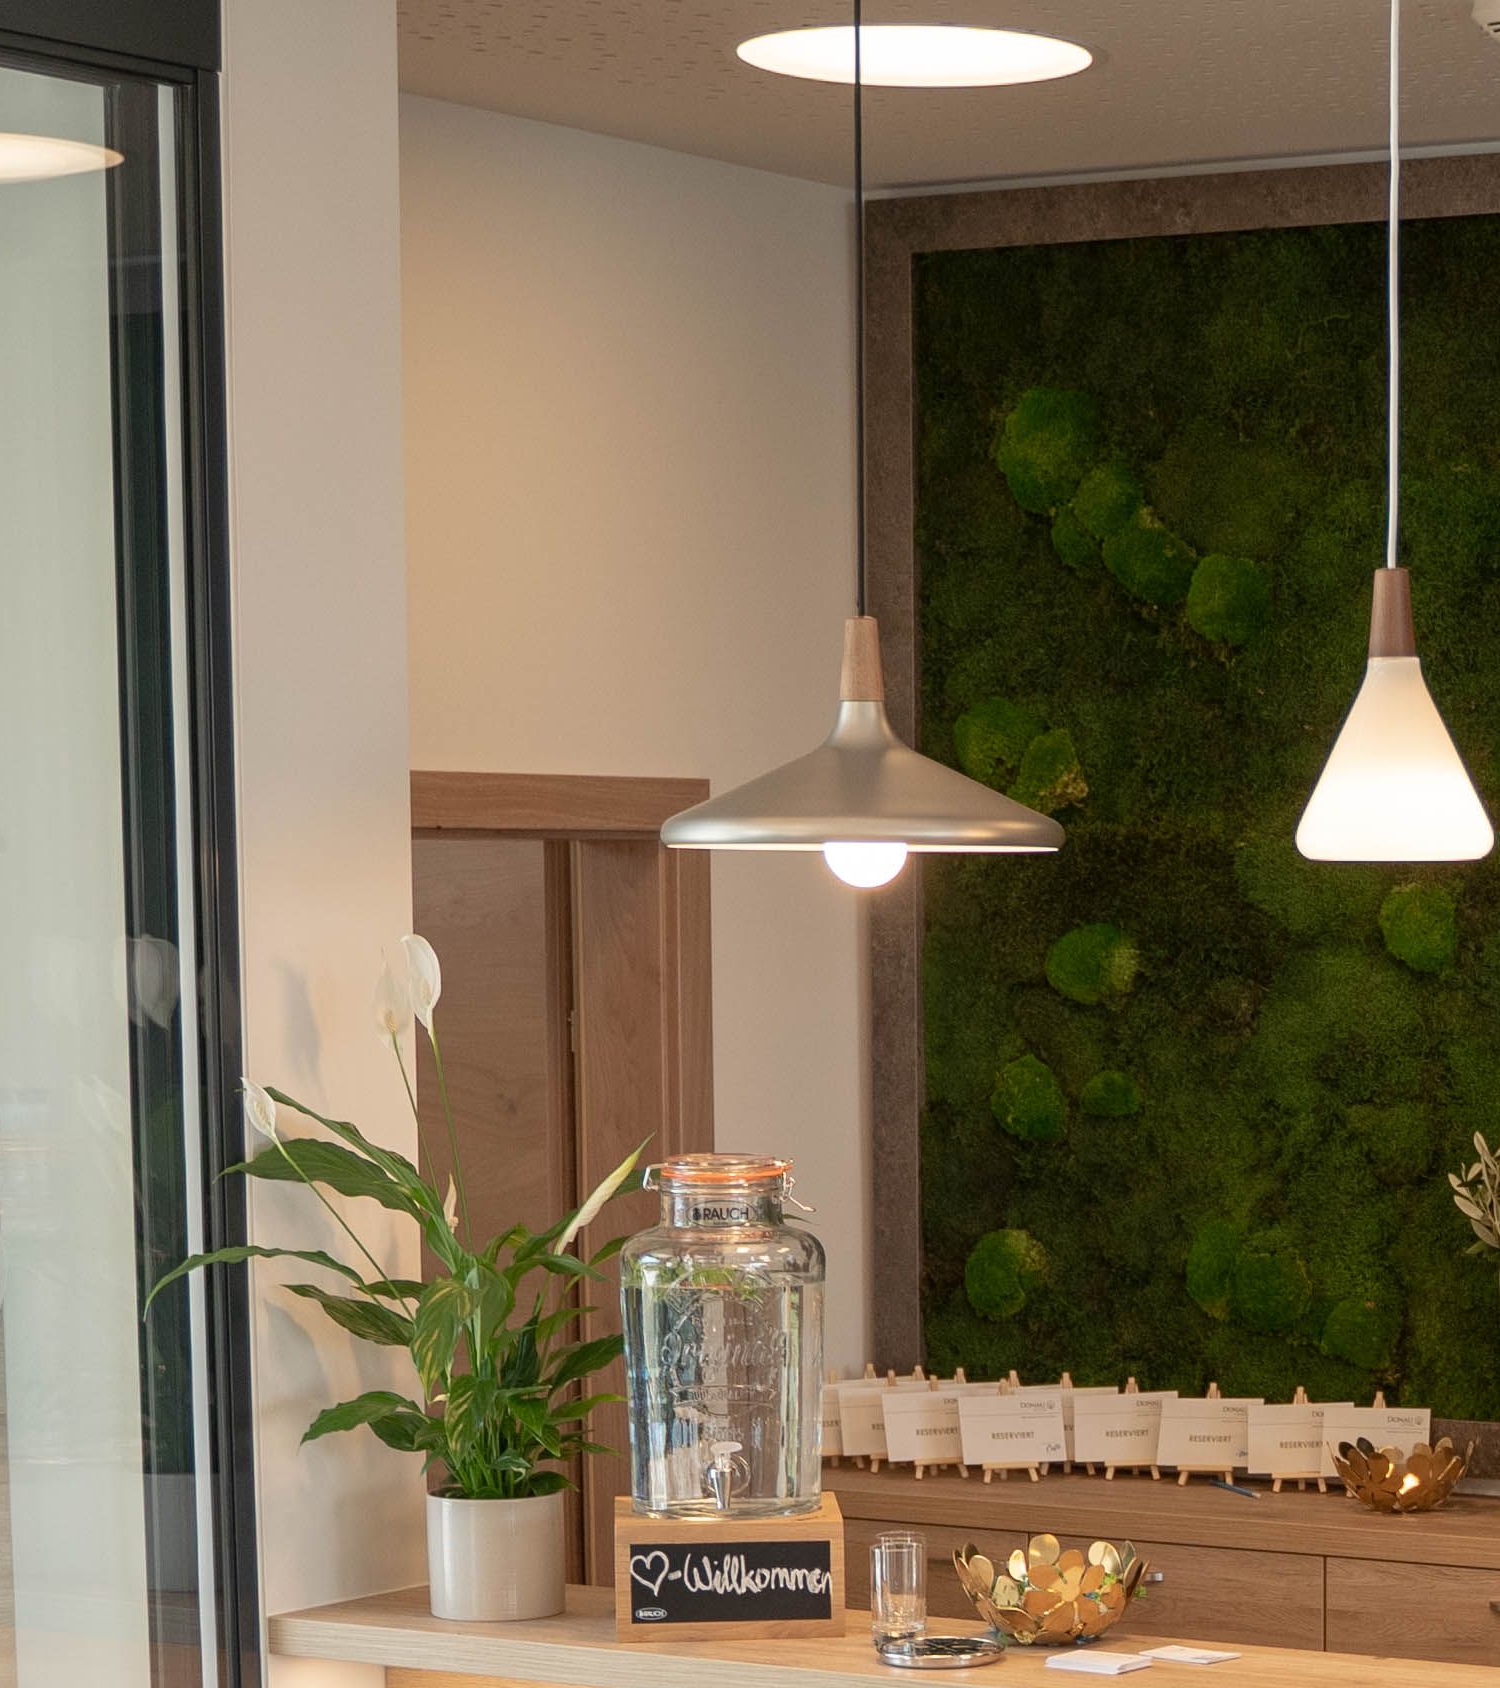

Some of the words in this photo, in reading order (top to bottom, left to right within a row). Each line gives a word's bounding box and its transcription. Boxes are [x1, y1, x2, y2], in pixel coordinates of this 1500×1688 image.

[703, 1207, 749, 1221] RAUCH
[991, 1431, 1035, 1440] RESERVIERT
[1105, 1429, 1149, 1438] RESERVIERT
[1189, 1434, 1232, 1443] RESERVIERT
